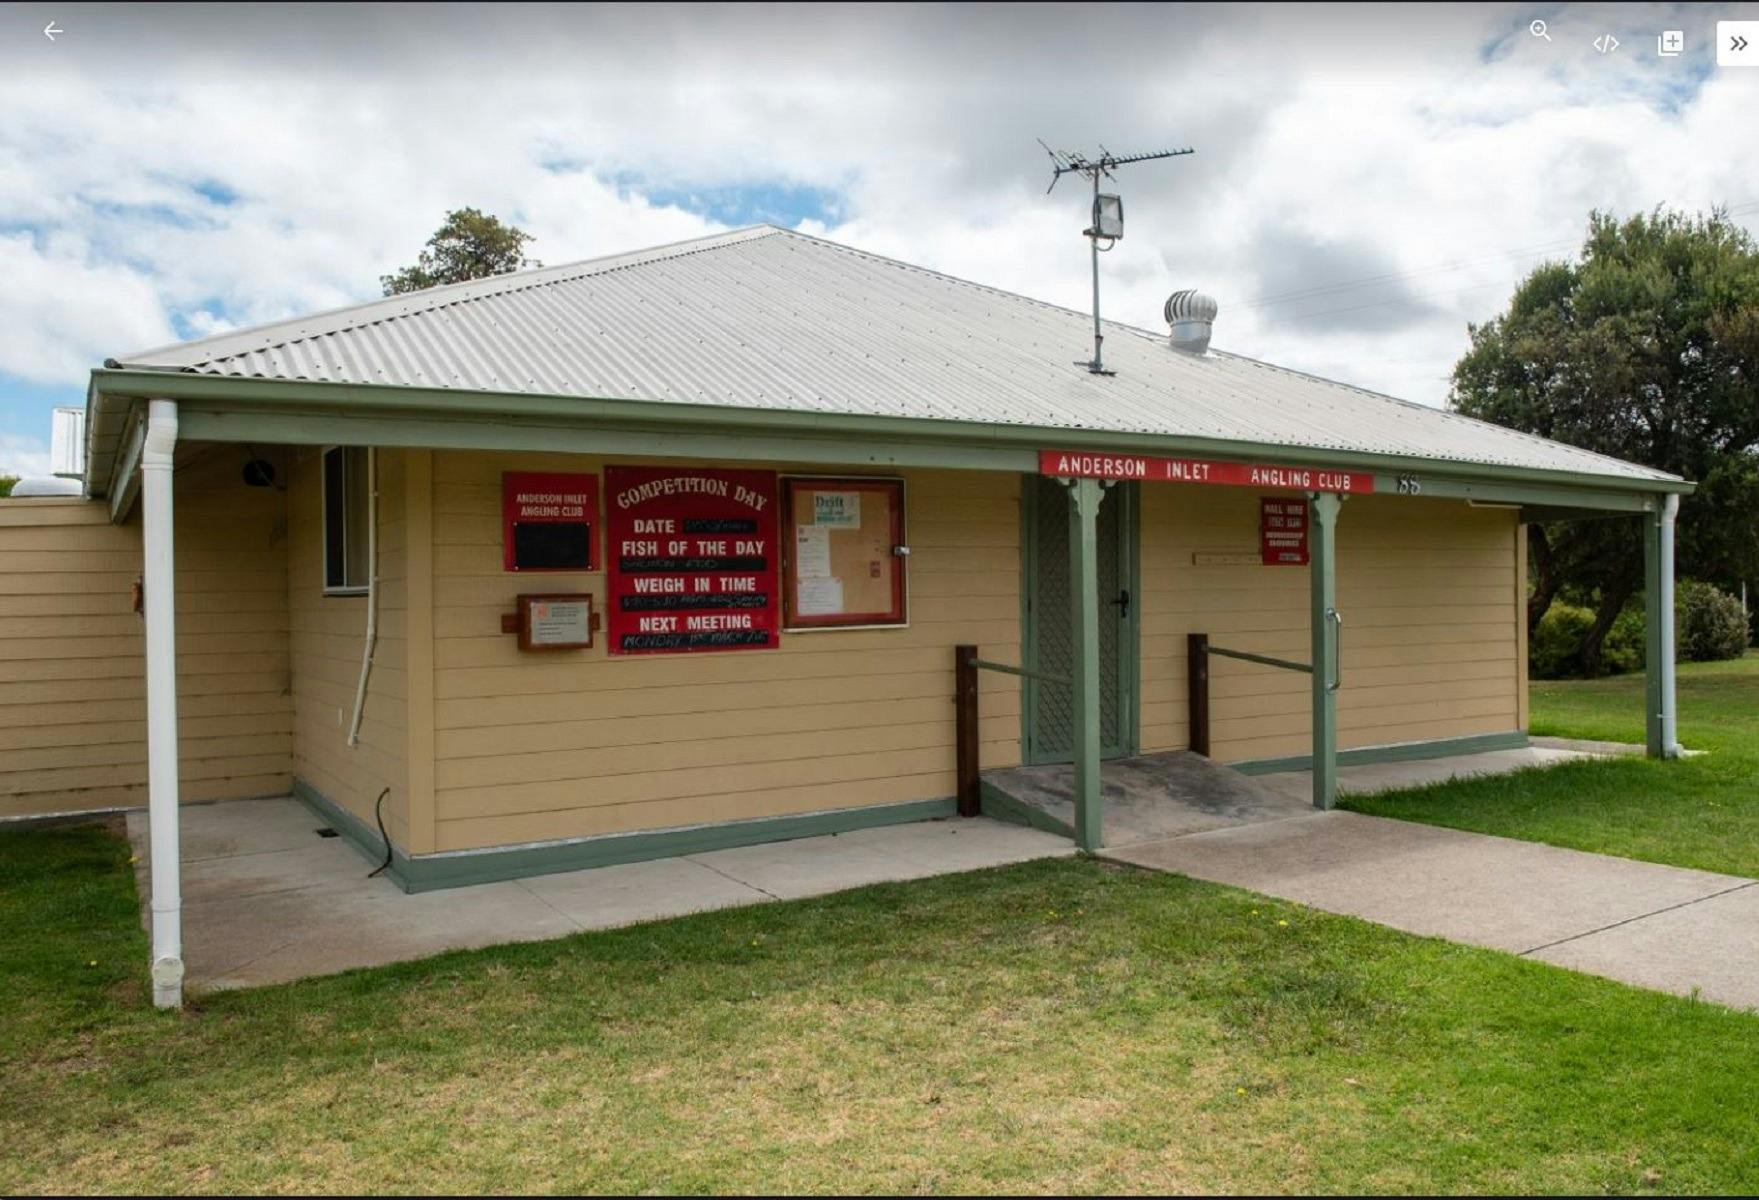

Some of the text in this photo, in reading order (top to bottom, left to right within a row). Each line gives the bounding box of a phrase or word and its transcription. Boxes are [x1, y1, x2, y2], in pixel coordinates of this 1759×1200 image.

[1058, 456, 1351, 490] ANDERSON INLET ANGLING CLUB
[516, 493, 587, 505] ANDERSON INLET
[617, 477, 768, 511] COMPETITION DAY
[521, 506, 583, 516] ANGLING CLUB
[634, 519, 675, 534] DATE
[622, 540, 764, 556] FISH OF THE DAY
[634, 577, 756, 593] WEIGH IN TIME
[640, 615, 752, 631] NEXT MEETING
